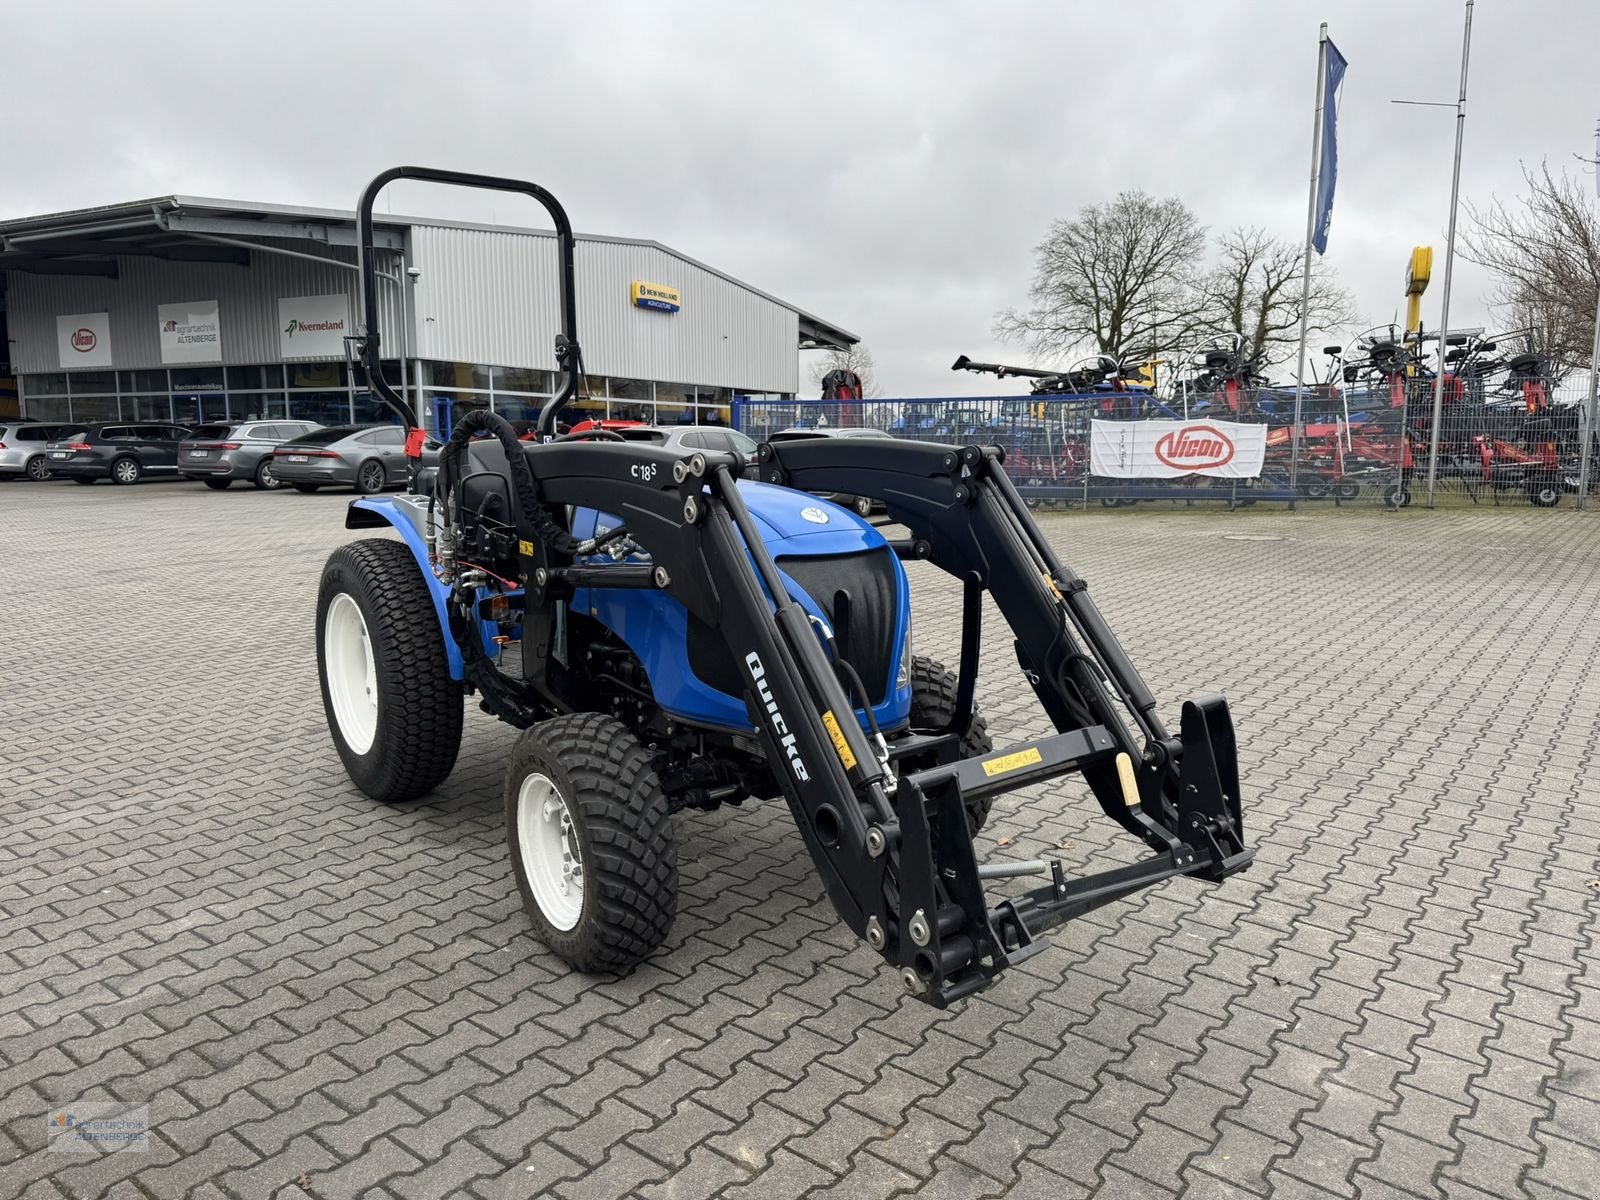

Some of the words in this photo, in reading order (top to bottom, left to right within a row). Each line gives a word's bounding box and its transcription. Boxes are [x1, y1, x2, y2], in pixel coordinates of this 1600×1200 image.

[658, 291, 677, 301] HOLLAND
[177, 322, 216, 335] agrartechnik
[298, 319, 343, 332] Kverneland
[178, 334, 216, 343] ALTENBERGE
[1167, 431, 1224, 458] Vicon
[745, 651, 809, 781] Quicke
